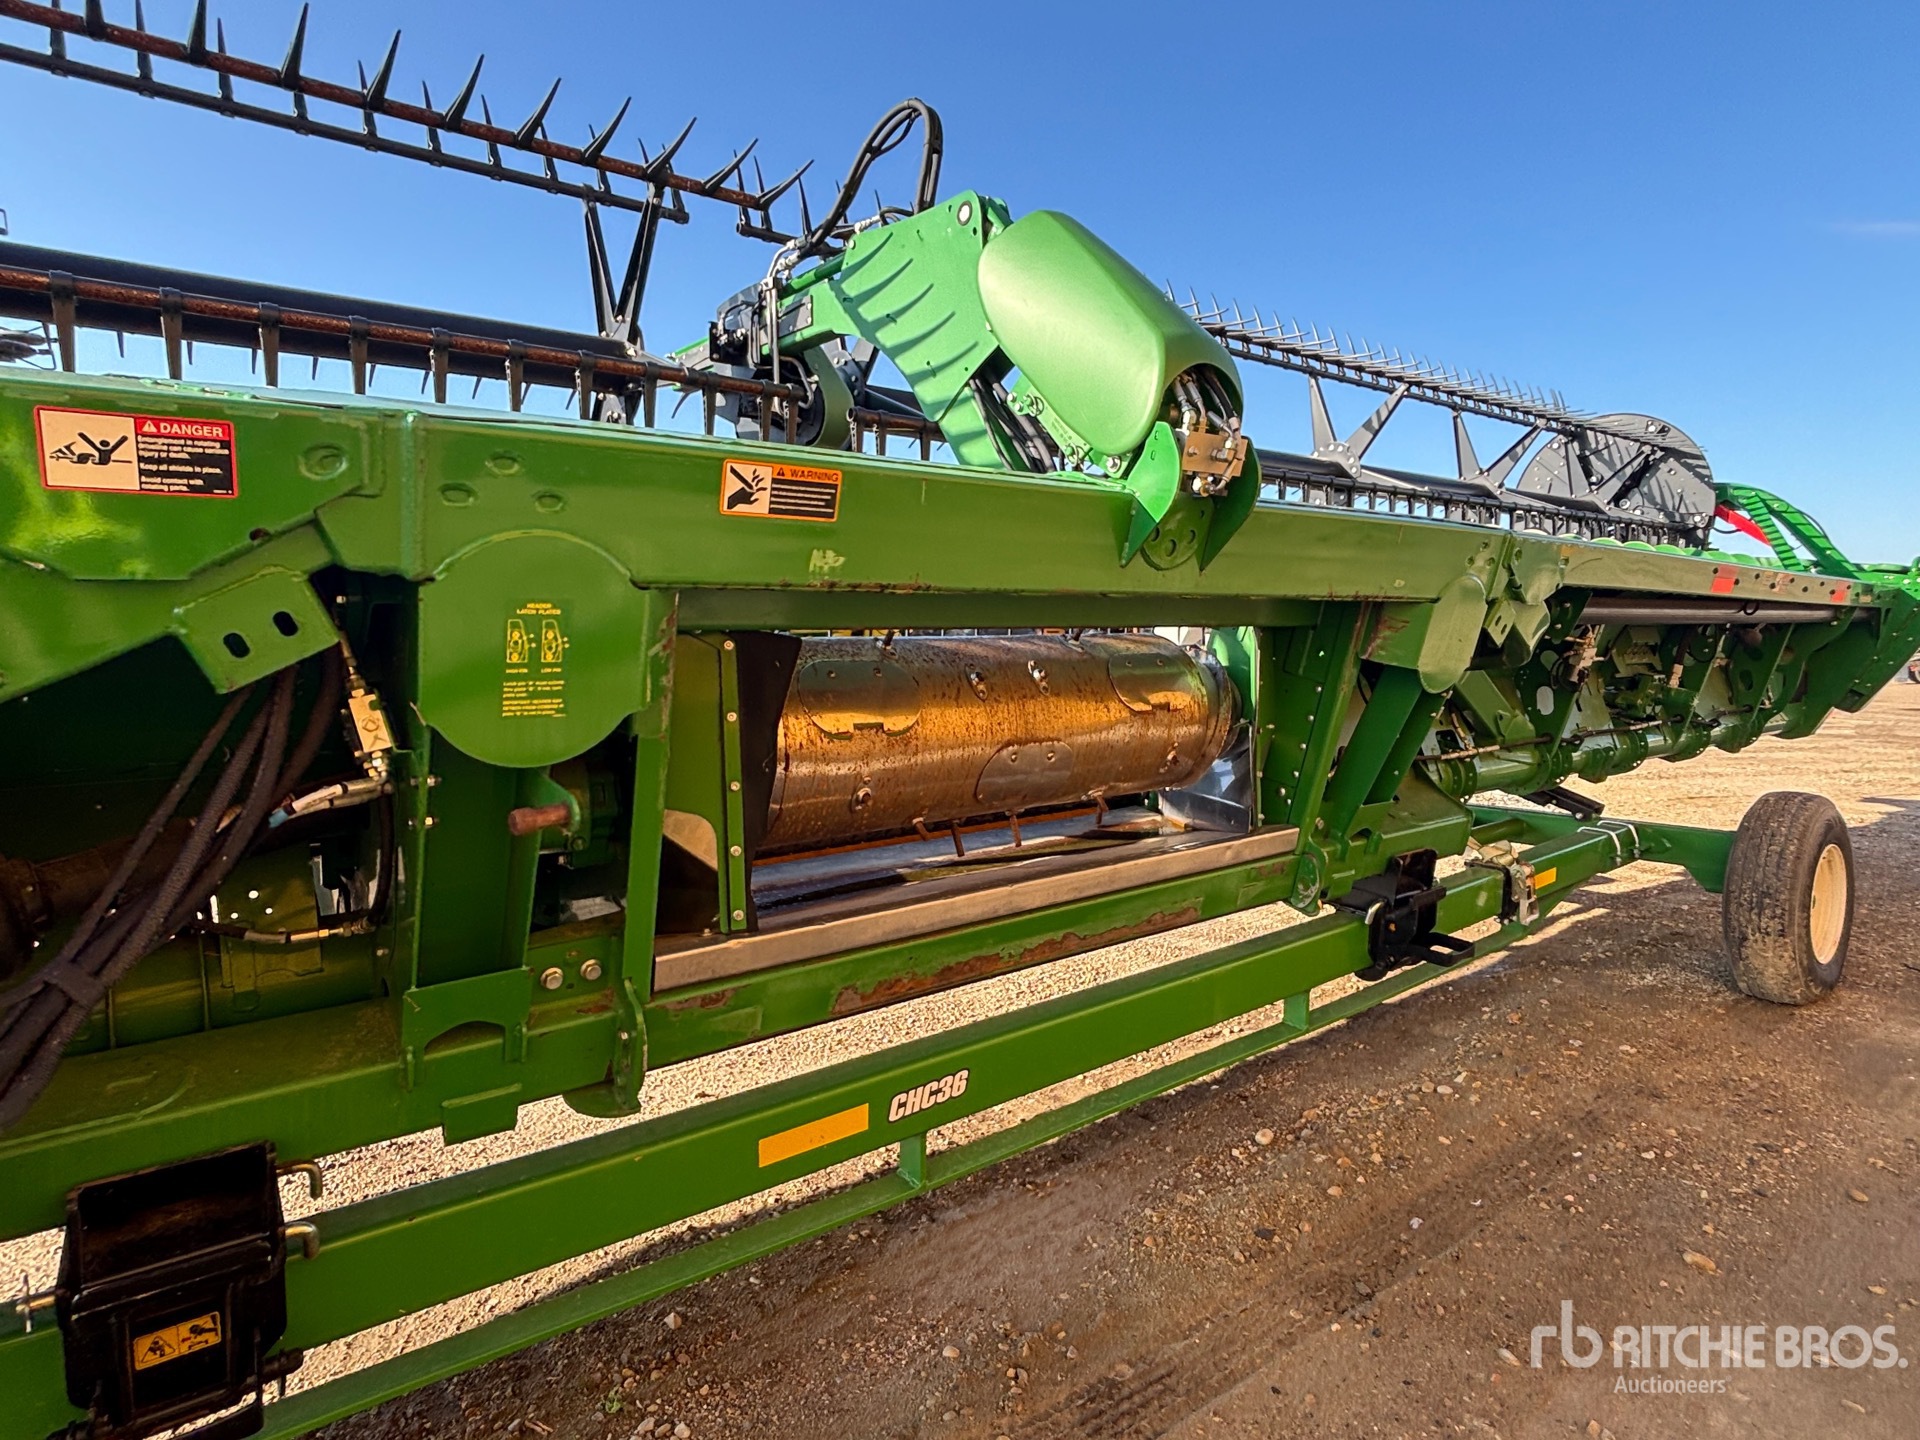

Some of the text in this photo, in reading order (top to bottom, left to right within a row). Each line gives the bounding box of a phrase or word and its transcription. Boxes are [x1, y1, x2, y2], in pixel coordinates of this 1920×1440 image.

[159, 422, 223, 437] DANGER
[790, 468, 839, 482] WARNING
[887, 1068, 970, 1123] CHC36
